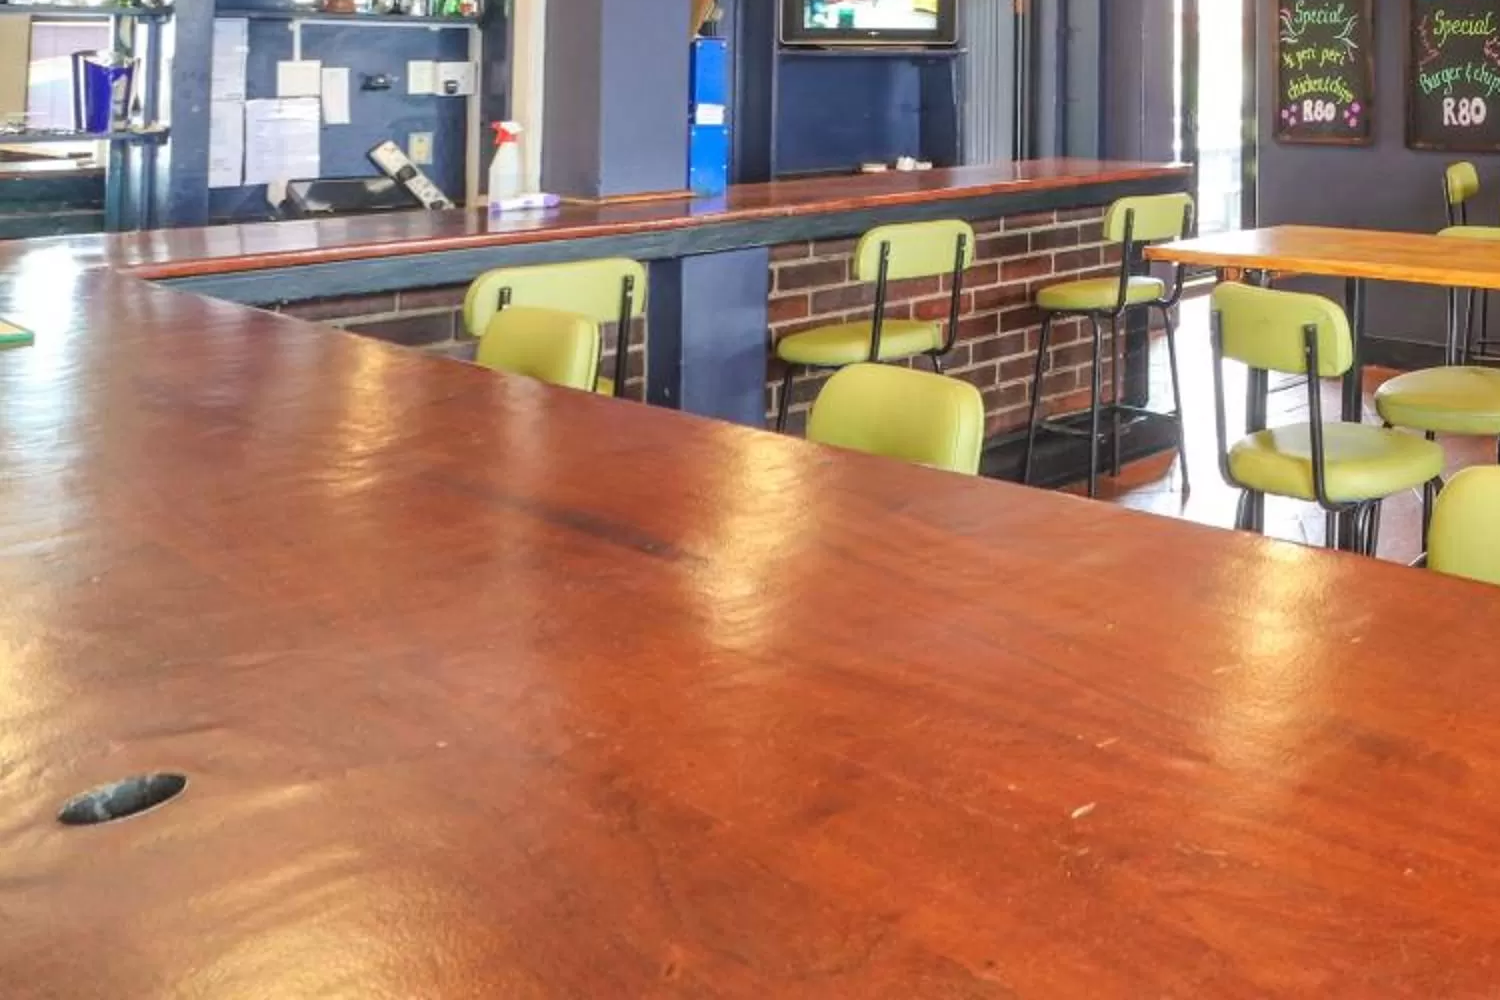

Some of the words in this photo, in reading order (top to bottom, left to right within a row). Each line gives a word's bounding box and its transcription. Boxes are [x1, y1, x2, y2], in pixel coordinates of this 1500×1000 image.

[1293, 0, 1349, 36] Special
[1433, 8, 1497, 48] Special
[1420, 67, 1463, 95] Burger
[1303, 98, 1337, 123] R80
[1443, 97, 1487, 127] R80
